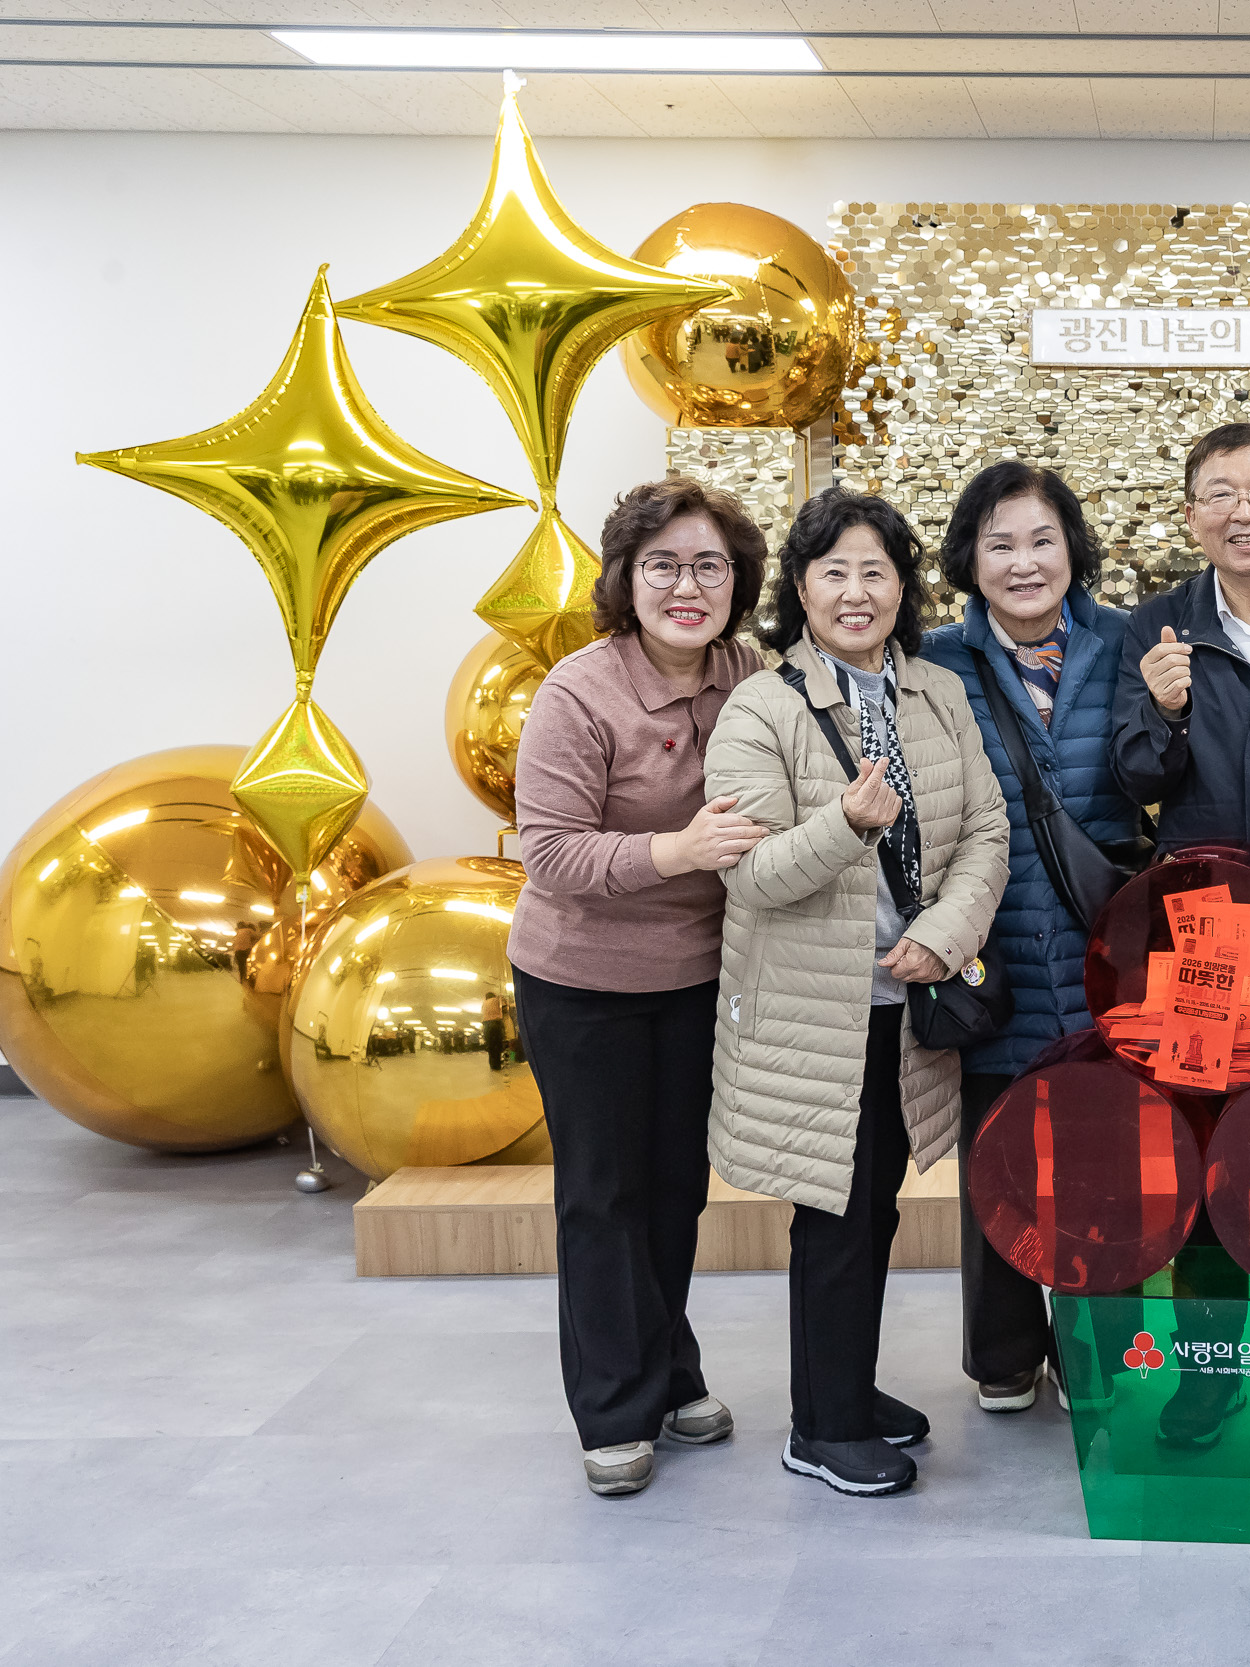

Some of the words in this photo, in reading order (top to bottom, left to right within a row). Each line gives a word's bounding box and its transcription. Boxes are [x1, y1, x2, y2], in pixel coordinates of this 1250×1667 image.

[1059, 317, 1127, 353] 광진
[1140, 317, 1241, 353] 나눔의
[1177, 914, 1195, 924] 2026
[1182, 958, 1202, 968] 2026
[1178, 967, 1234, 991] 따뜻한
[1169, 1341, 1233, 1364] 사랑의
